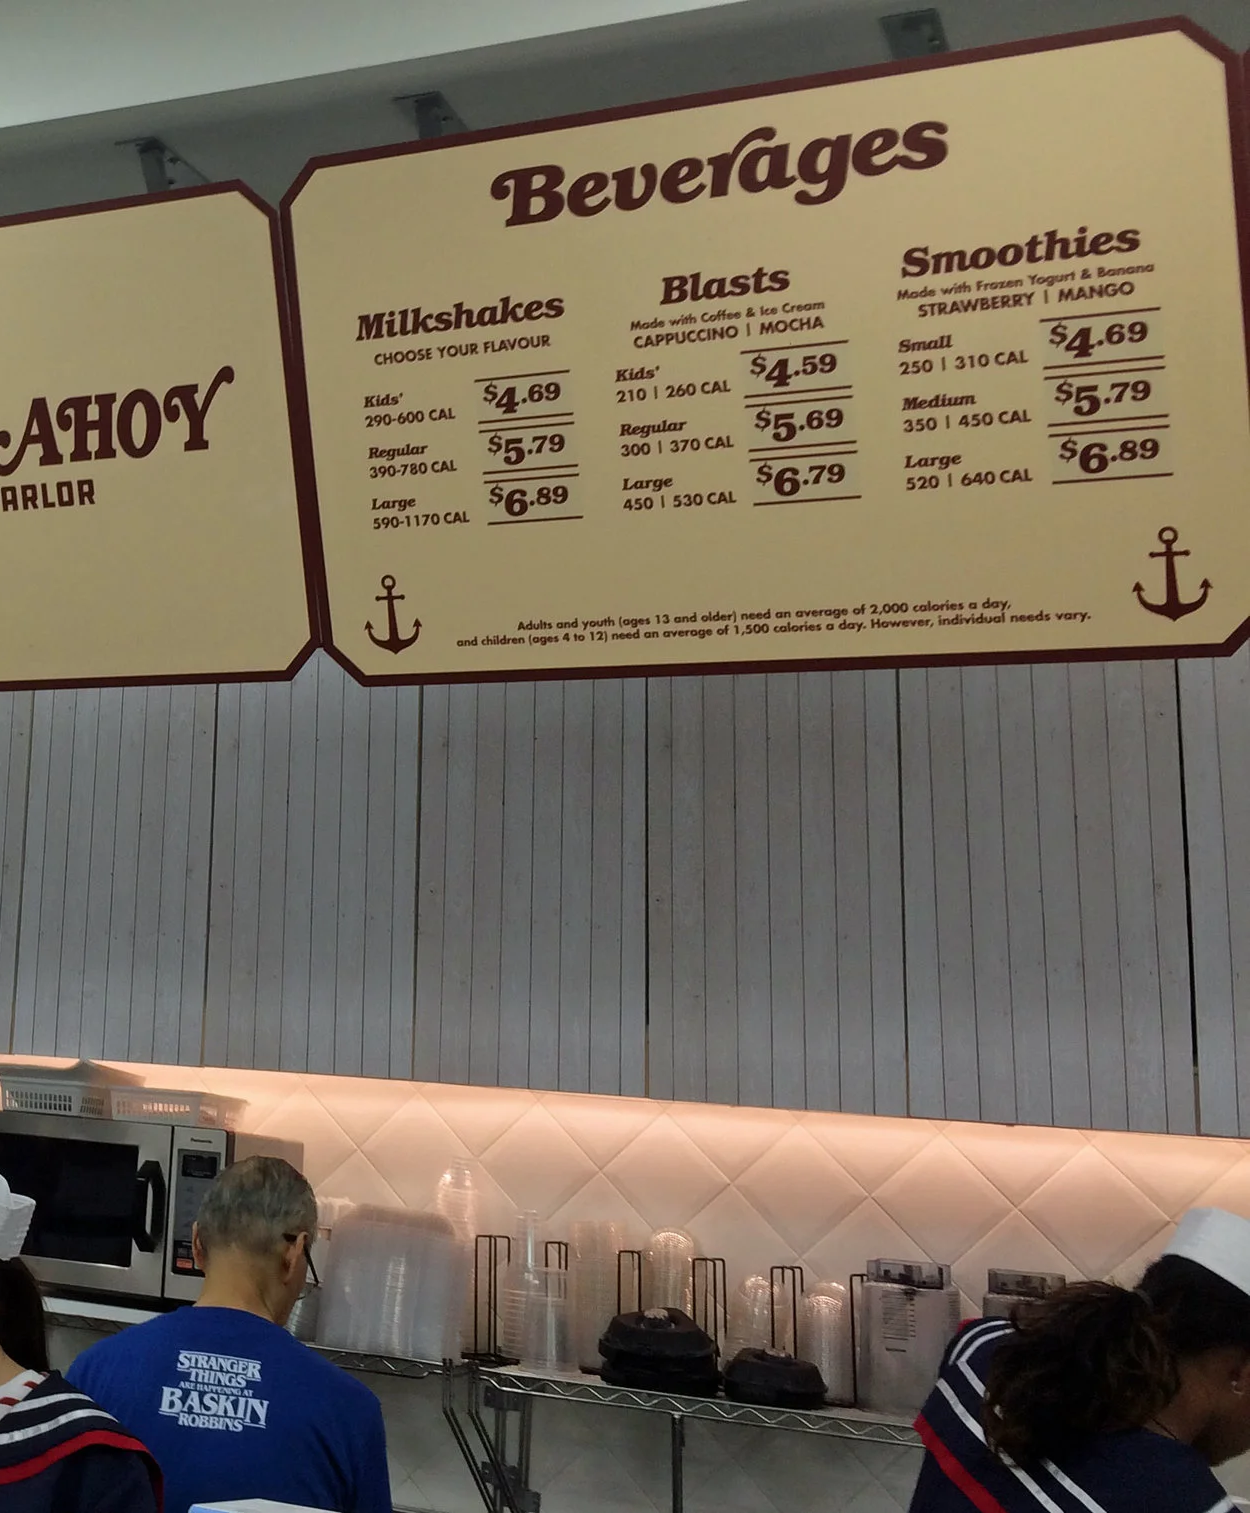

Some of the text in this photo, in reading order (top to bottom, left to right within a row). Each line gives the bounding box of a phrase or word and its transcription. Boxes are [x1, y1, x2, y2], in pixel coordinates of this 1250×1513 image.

[490, 121, 948, 228] Beverages
[901, 226, 1141, 279] Smoothies
[660, 267, 790, 305] Blasts
[897, 264, 1154, 300] Made with Frozen Yogurt & Banana
[918, 281, 1135, 318] STRAWBERRY MANGO
[356, 296, 565, 341] Milkshakes
[630, 302, 825, 331] Made with Coffee & Ice Cream
[633, 316, 824, 349] CAPPUCCINO MOCHA
[898, 334, 953, 353] Small
[1049, 321, 1148, 359] $4.69
[374, 335, 550, 365] CHOOSE YOUR FLAVOUR
[899, 350, 1028, 375] 250 310 CAL
[615, 365, 660, 382] Kids'
[750, 353, 837, 388] $4.59
[364, 392, 403, 408] Kids'
[483, 382, 561, 414] $4.69
[616, 380, 731, 403] 210 260 CAL
[902, 394, 976, 411] Medium
[1055, 380, 1151, 416] $5.79
[365, 408, 456, 428] 290-600 CAL
[619, 420, 687, 438] Regular
[754, 408, 844, 442] $5.69
[904, 409, 1032, 433] 350 450 CAL
[368, 443, 428, 461] Regular
[487, 433, 565, 465] $5.79
[621, 435, 734, 457] 300 370 CAL
[1059, 438, 1159, 474] $6.89
[369, 460, 457, 479] 390-780 CAL
[904, 455, 962, 470] Large
[622, 478, 673, 492] Large
[756, 462, 845, 497] $6.79
[907, 468, 1033, 491] 520 640 CAL
[371, 498, 416, 512] Large
[489, 484, 568, 517] $6.89
[623, 491, 737, 511] 450 530 CAL
[373, 511, 470, 530] 590-1170 CAL
[517, 597, 1011, 631] Adults and youth (ages 13 and older) need an average of 2,000 calories a day,
[177, 1353, 262, 1378] STRANGER
[189, 1369, 247, 1387] THINGS
[179, 1381, 254, 1397] ARE HAPPENING AT
[160, 1386, 269, 1425] BASKIN
[178, 1413, 244, 1432] ROBBINS
